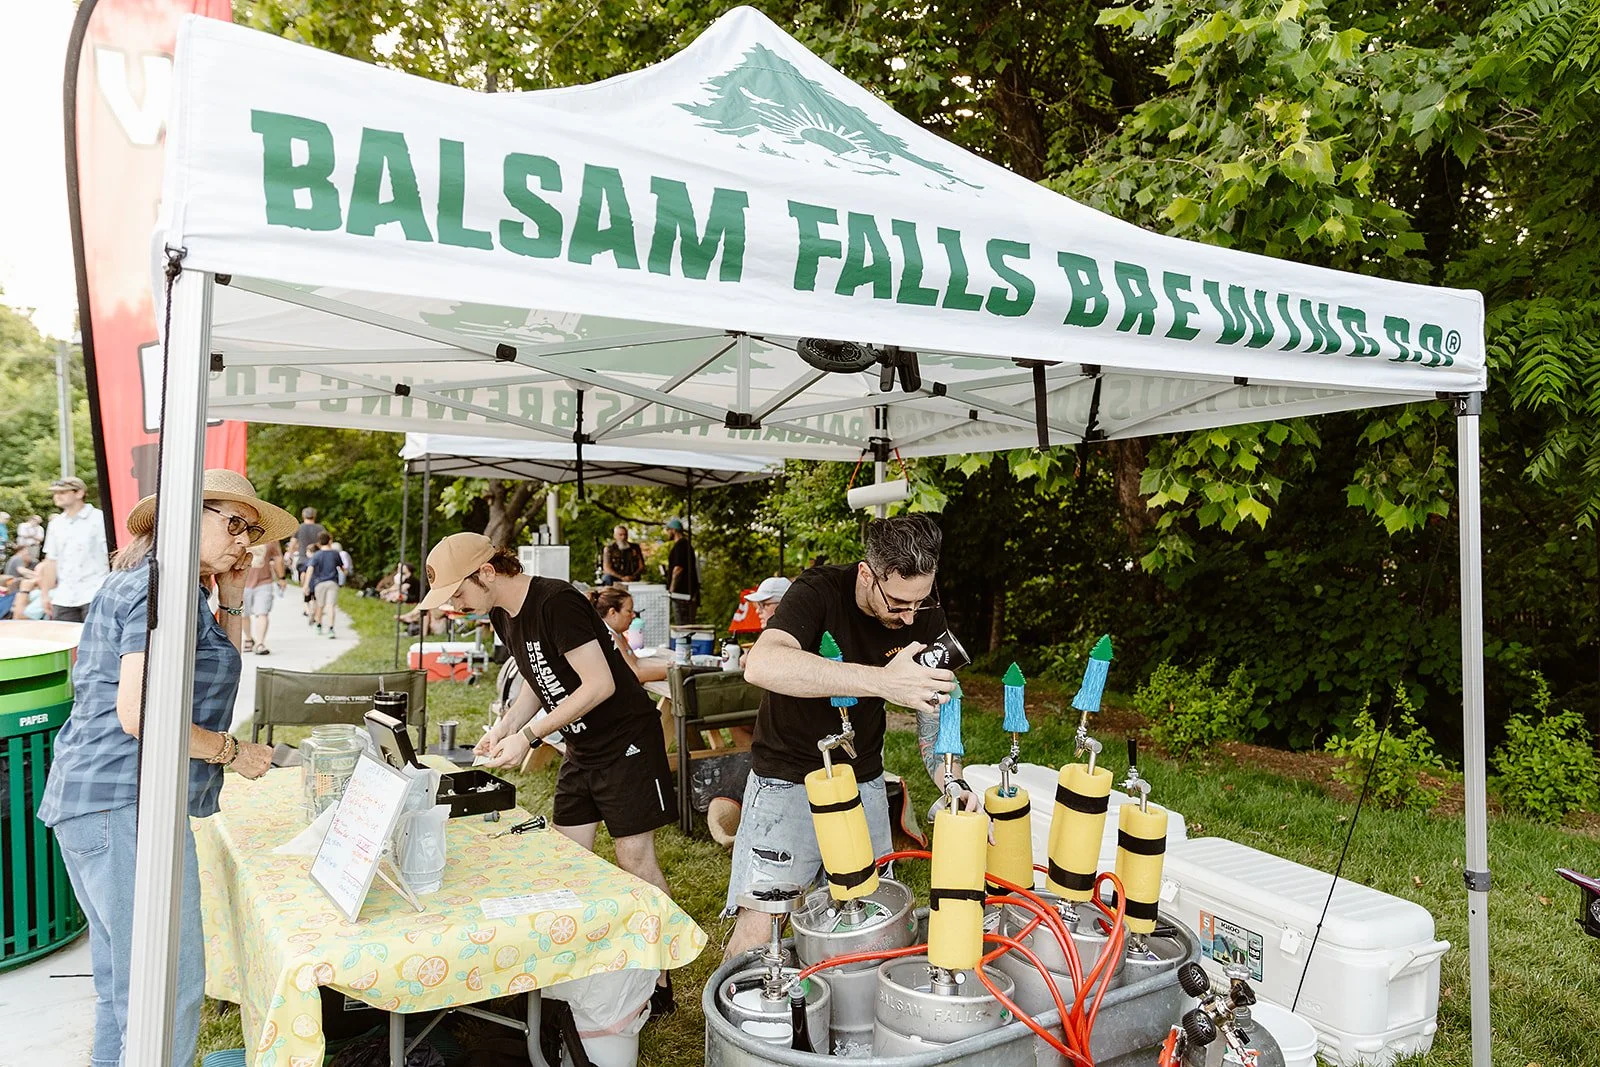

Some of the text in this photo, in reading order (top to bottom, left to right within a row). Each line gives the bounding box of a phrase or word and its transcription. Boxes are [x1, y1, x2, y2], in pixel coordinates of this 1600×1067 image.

[250, 109, 749, 283] BALSAM
[786, 200, 1035, 317] FALLS
[1057, 251, 1380, 358] BREWING
[532, 641, 566, 697] BALSAM
[19, 713, 49, 727] PAPER
[933, 1008, 983, 1024] FALLS
